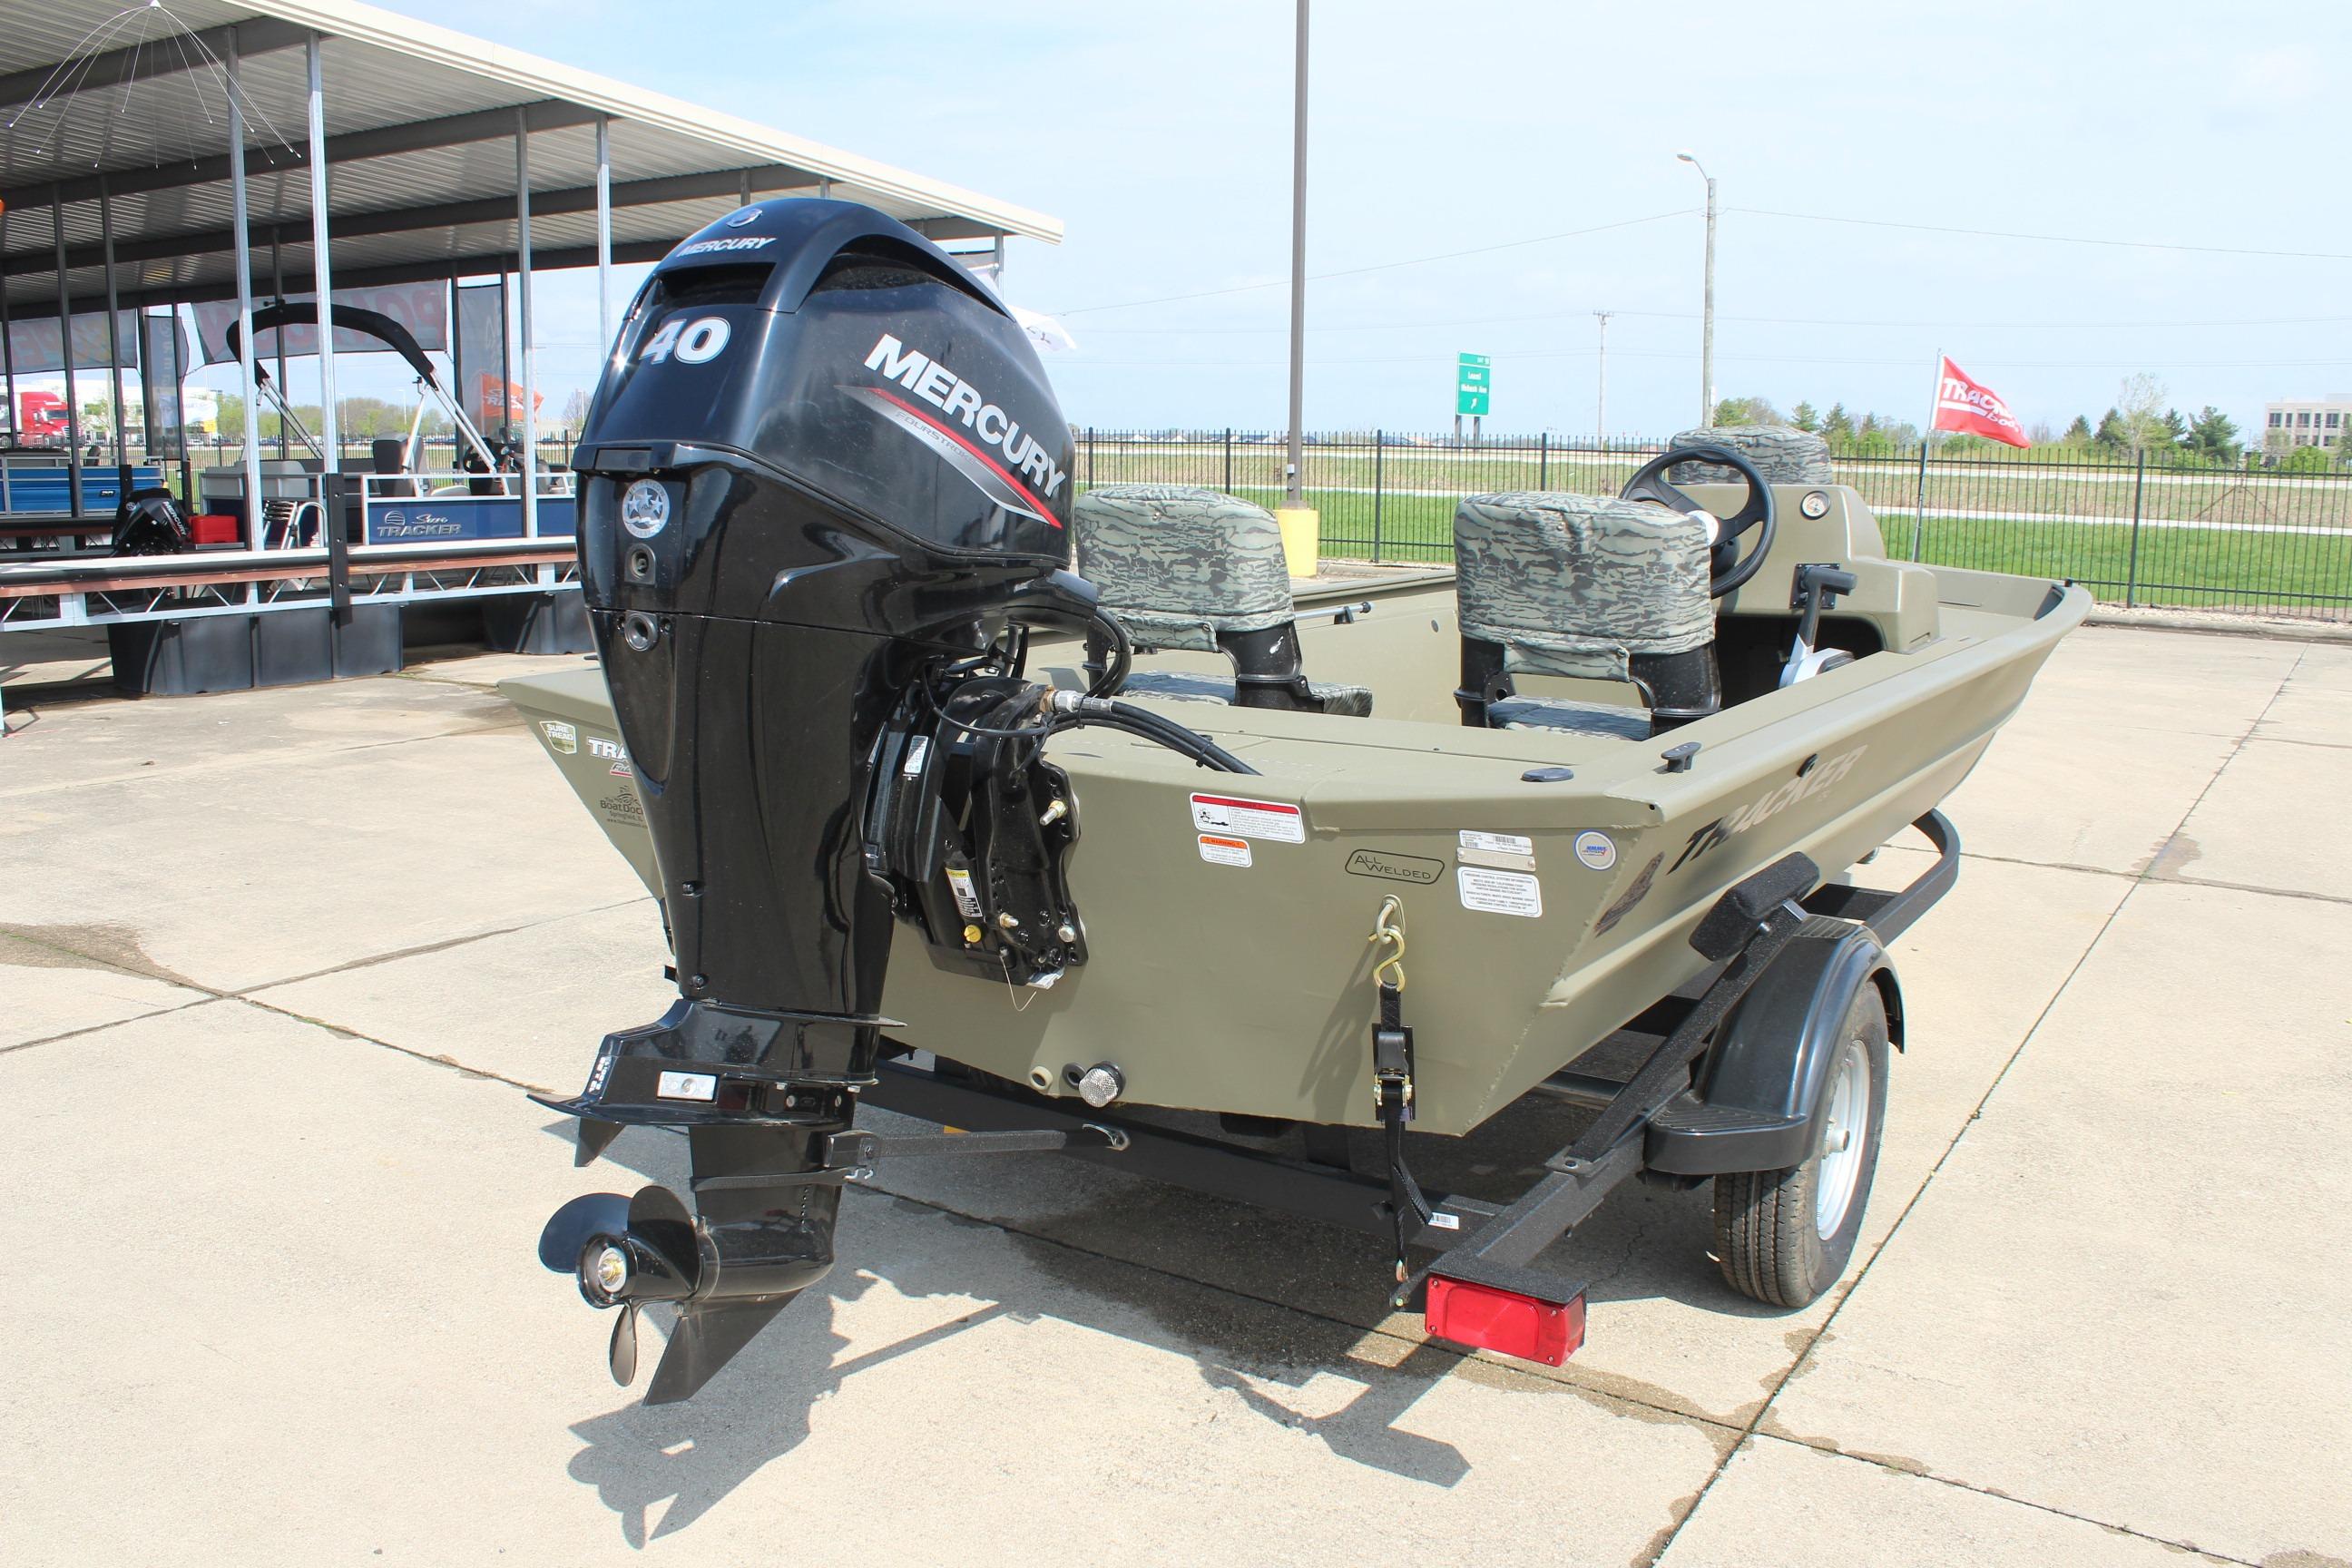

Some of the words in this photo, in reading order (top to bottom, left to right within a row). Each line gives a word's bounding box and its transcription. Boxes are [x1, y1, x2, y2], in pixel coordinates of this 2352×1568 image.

[676, 237, 779, 258] MERCURY
[639, 316, 731, 365] 40
[863, 333, 1066, 498] MERCURY
[162, 501, 187, 536] MERCURY
[377, 524, 462, 537] TRACKER
[545, 723, 570, 734] SURE
[547, 730, 574, 741] TREAD
[1666, 744, 1869, 876] TRACKER
[1355, 855, 1382, 865] ALL
[1363, 861, 1431, 879] WELDED
